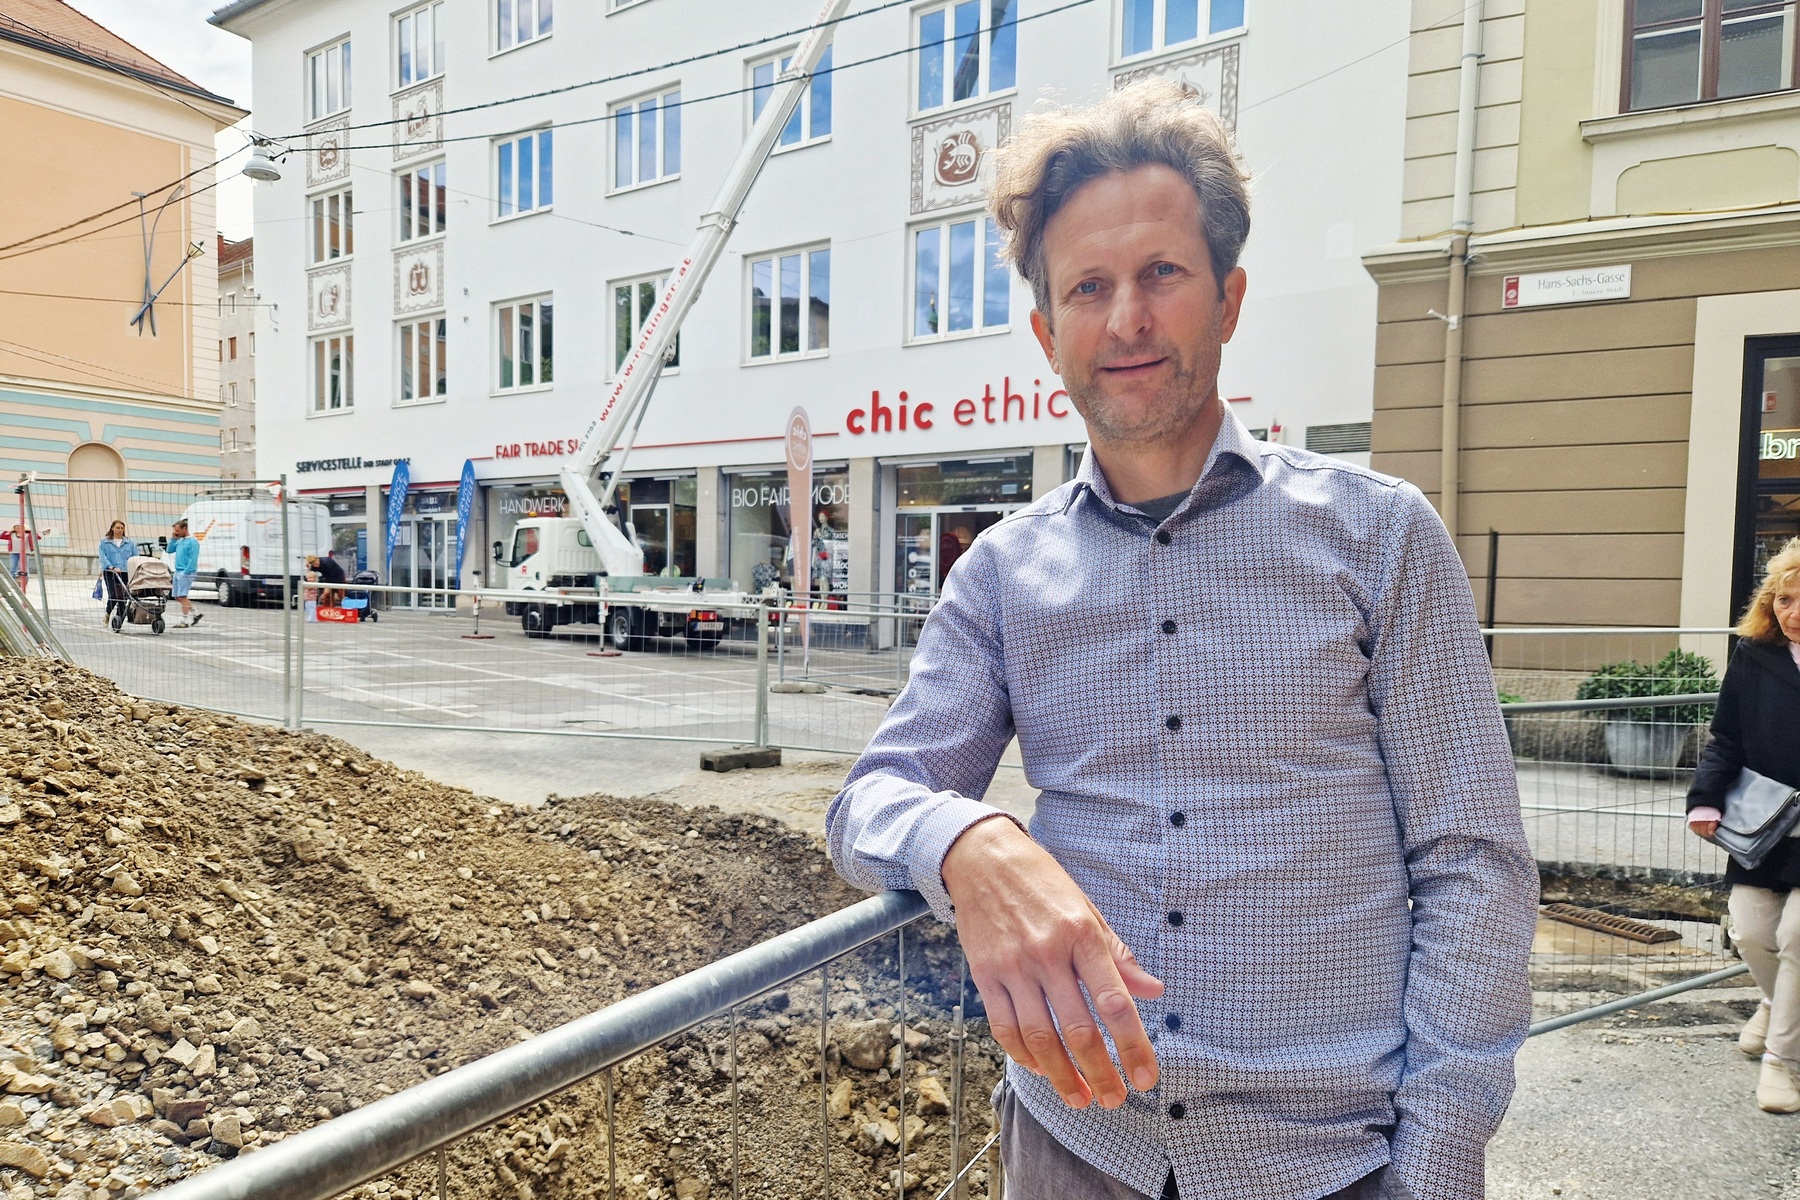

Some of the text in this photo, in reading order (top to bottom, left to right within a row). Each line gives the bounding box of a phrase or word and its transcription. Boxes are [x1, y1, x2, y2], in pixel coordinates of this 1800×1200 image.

[1537, 273, 1626, 290] Hans-Sachs-Gasse
[600, 257, 692, 422] www.w-reitinger.at
[846, 376, 1069, 435] chic ethic
[495, 444, 521, 459] FAIR
[524, 440, 564, 457] TRADE
[296, 457, 362, 473] SERVICESTELLE
[393, 457, 411, 467] GZ
[500, 496, 567, 514] HANDWERK
[732, 487, 759, 508] BIO
[760, 486, 791, 507] FAIR
